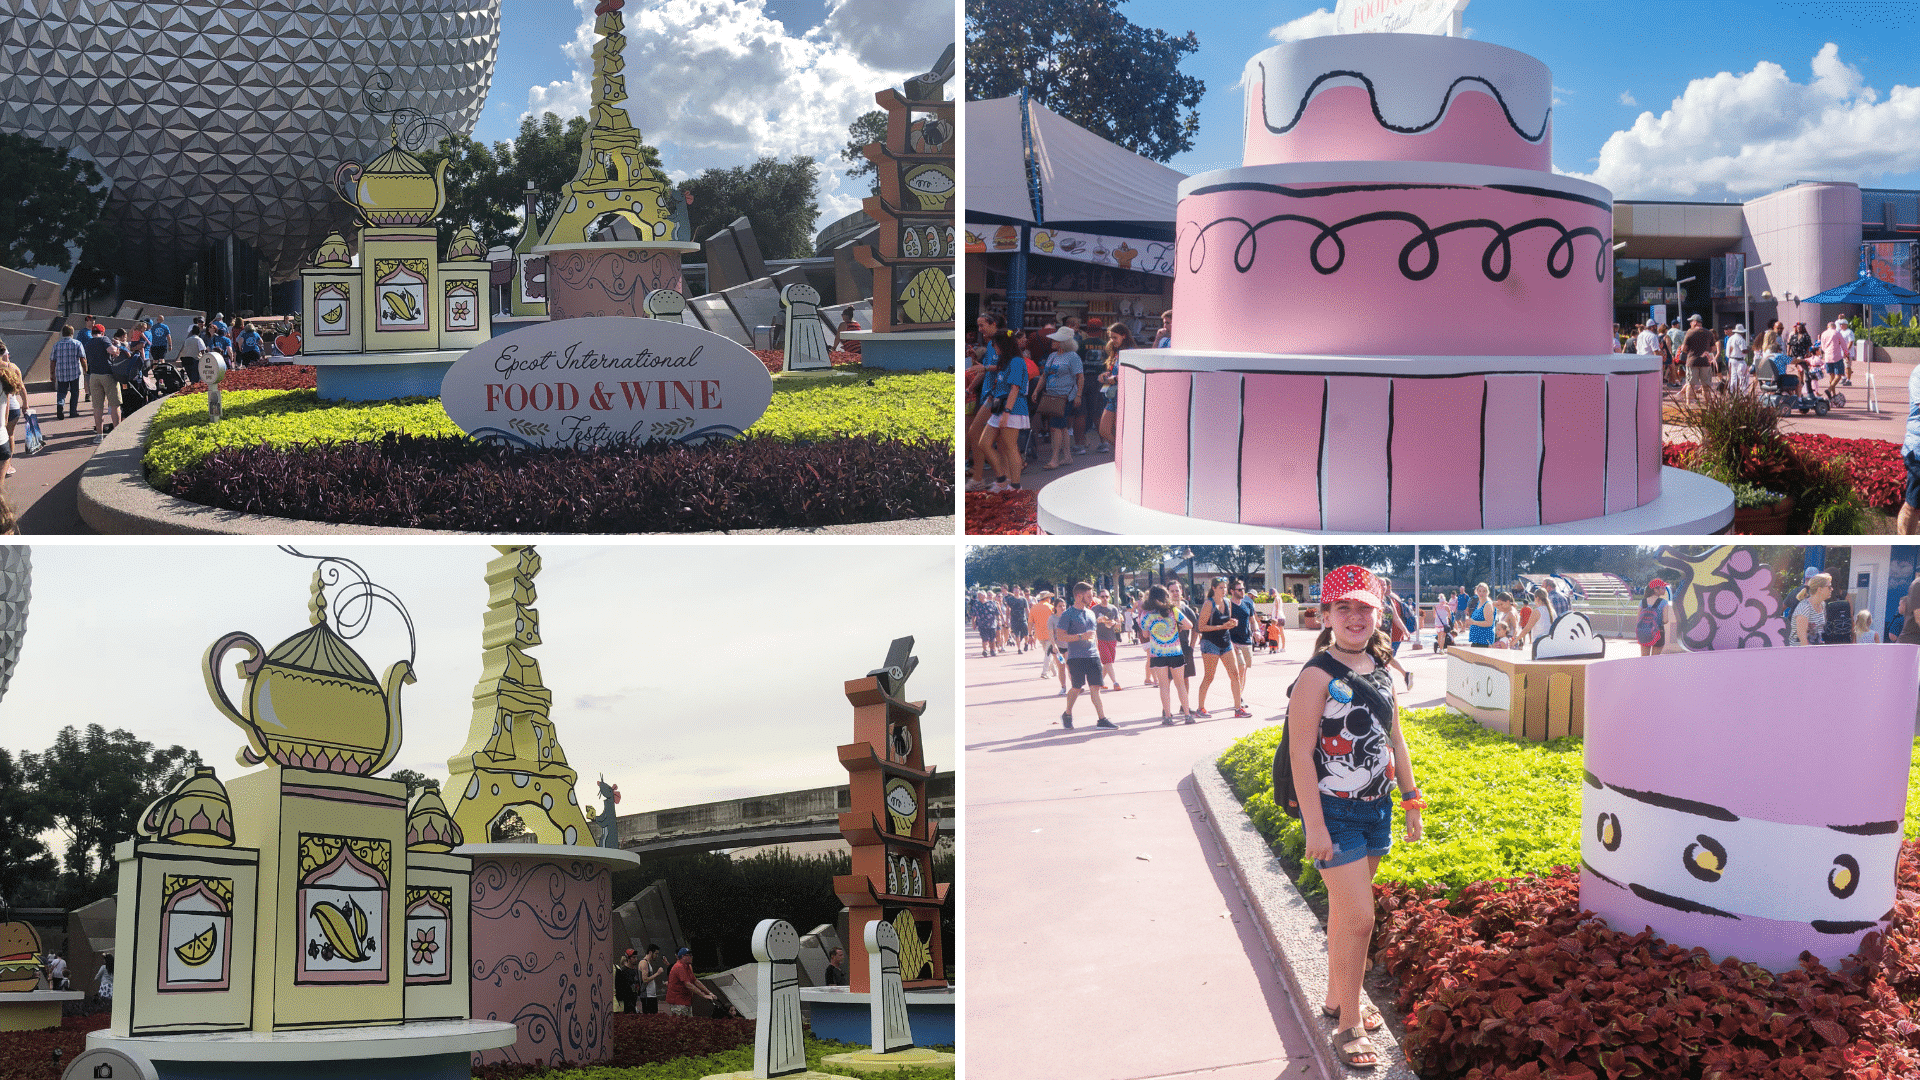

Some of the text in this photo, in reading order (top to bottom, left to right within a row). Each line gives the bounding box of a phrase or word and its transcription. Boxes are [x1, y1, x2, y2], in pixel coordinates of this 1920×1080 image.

[1643, 291, 1663, 300] LIGHT
[494, 341, 704, 380] Epcot International
[483, 379, 723, 412] FOOD & WINE
[556, 415, 644, 443] Festival
